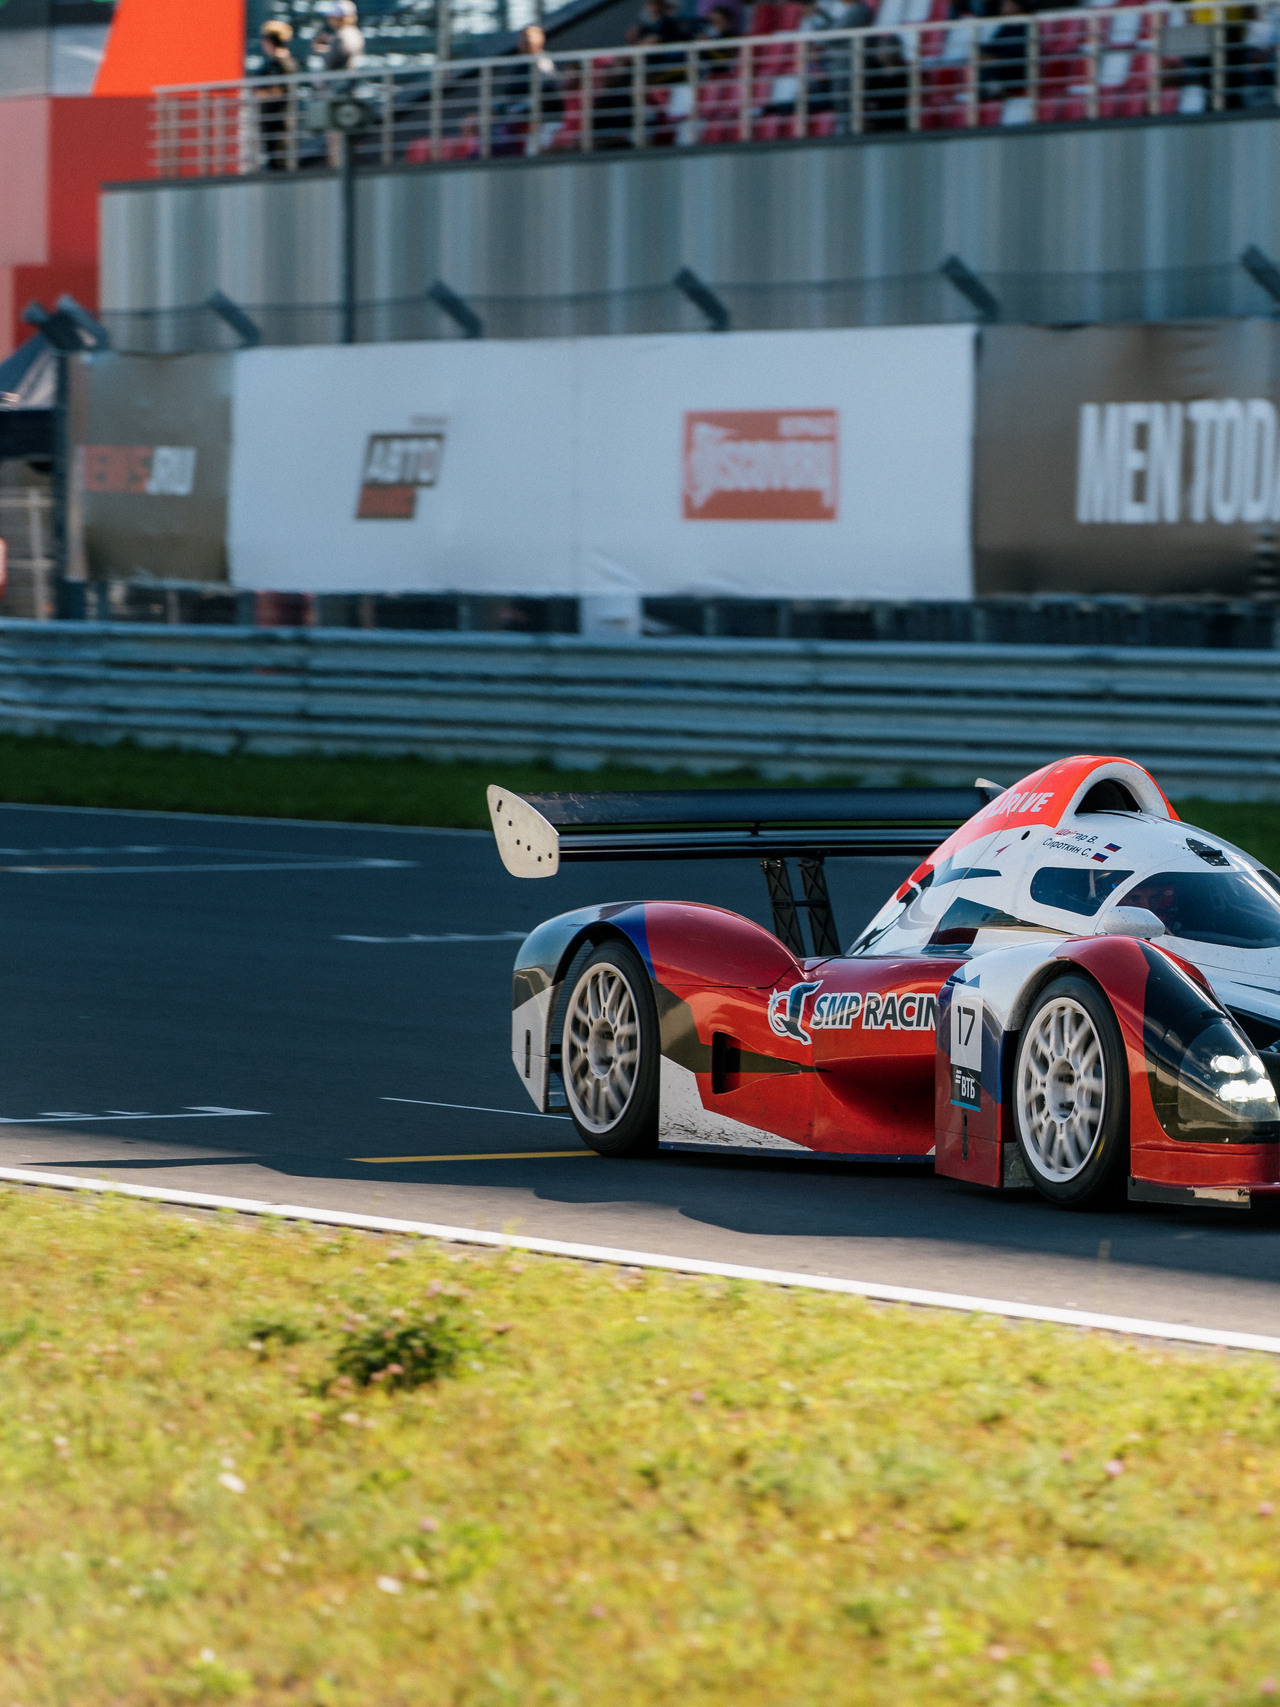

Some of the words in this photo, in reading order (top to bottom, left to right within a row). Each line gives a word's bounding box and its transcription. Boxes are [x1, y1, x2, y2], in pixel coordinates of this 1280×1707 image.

[1076, 401, 1184, 524] MEN
[810, 992, 862, 1029] SMP
[862, 992, 937, 1030] RACIN
[957, 1005, 976, 1047] 17
[961, 1075, 976, 1100] ВТБ
